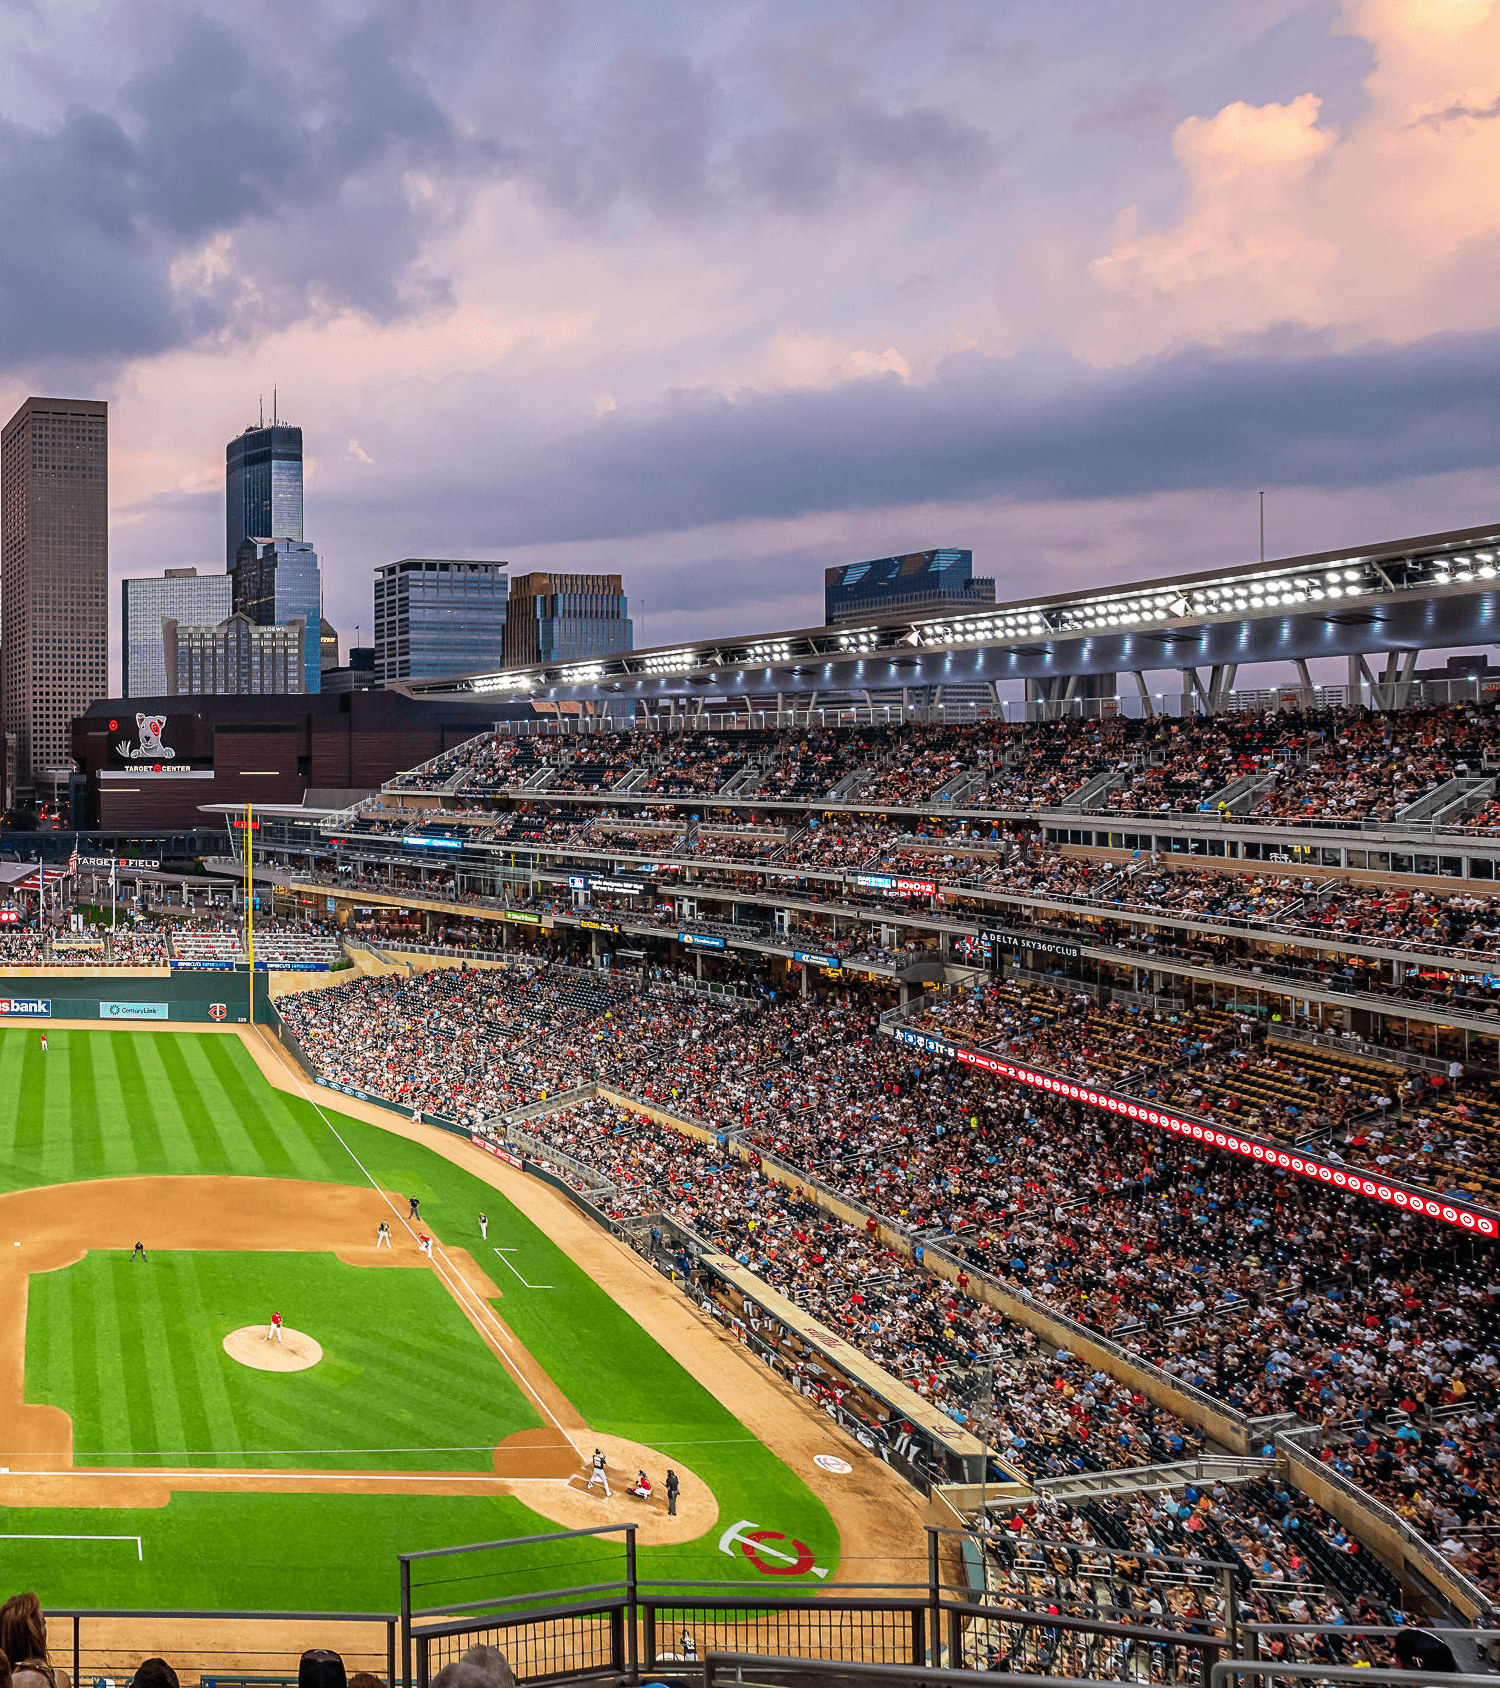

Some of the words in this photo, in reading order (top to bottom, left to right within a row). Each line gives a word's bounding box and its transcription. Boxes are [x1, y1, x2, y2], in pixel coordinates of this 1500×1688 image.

[77, 858, 116, 866] TARGET
[129, 860, 160, 868] FIELD
[990, 933, 1018, 945] DELTA
[968, 1054, 976, 1062] 0
[990, 1061, 997, 1069] 0
